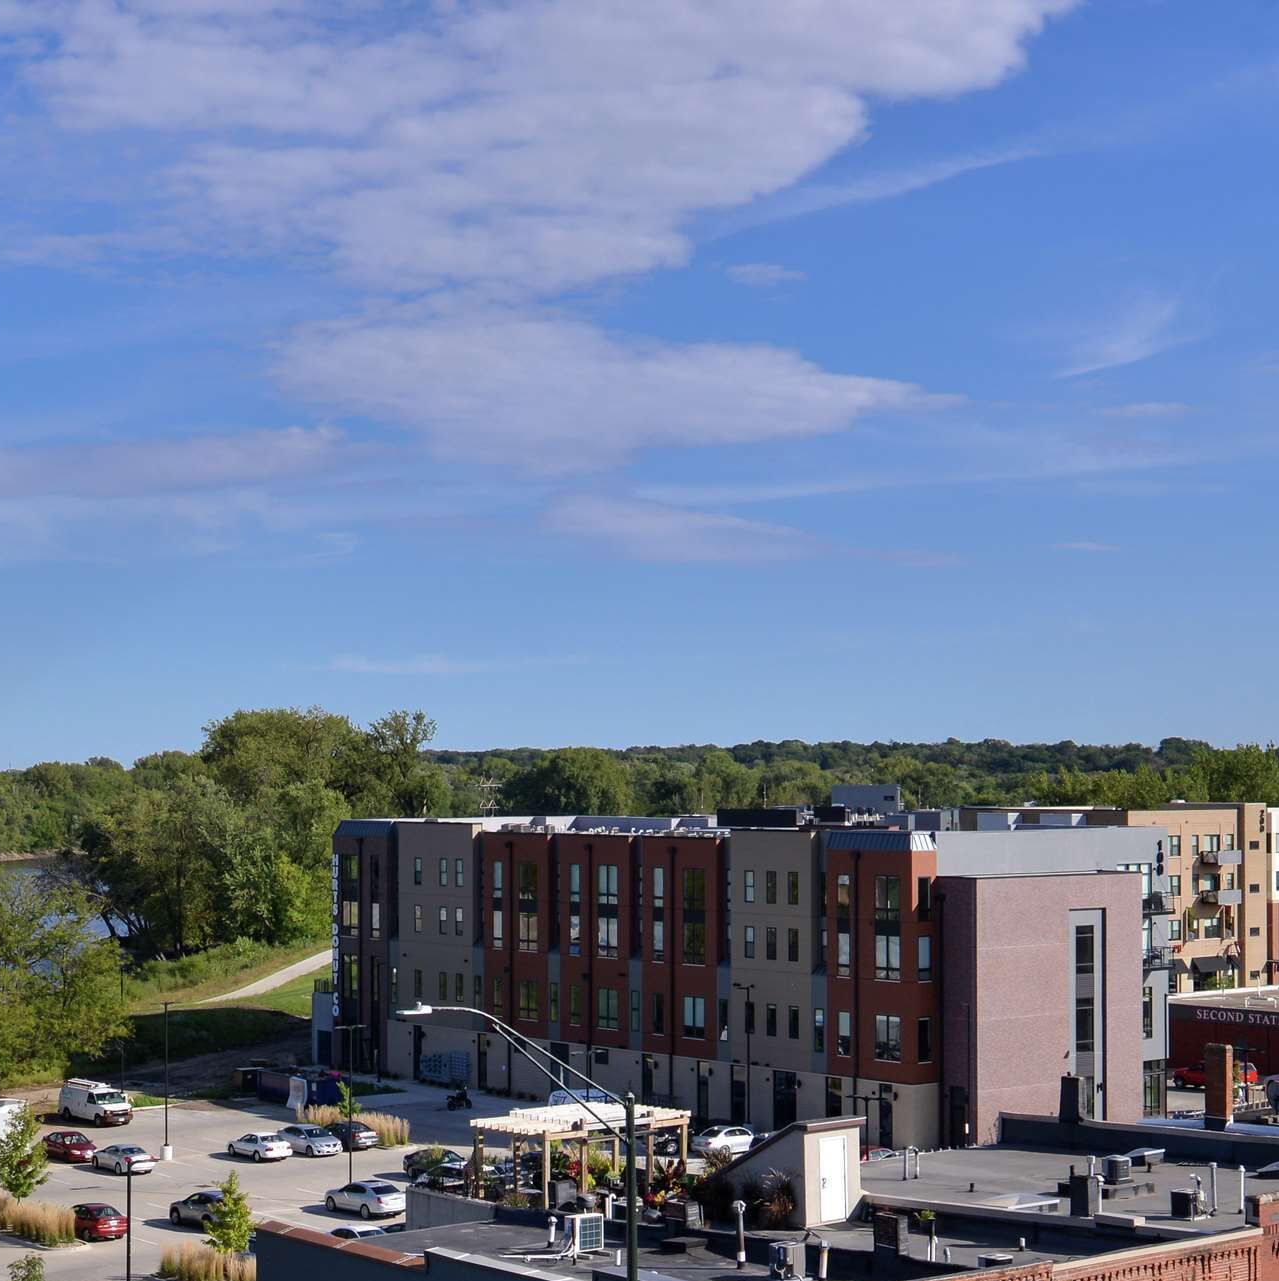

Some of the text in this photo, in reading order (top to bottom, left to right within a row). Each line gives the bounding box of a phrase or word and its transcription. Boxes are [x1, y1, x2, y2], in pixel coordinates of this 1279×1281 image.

[1156, 839, 1164, 877] 100
[331, 853, 340, 1017] HURTS DONUT CO
[1196, 1008, 1244, 1023] SECOND
